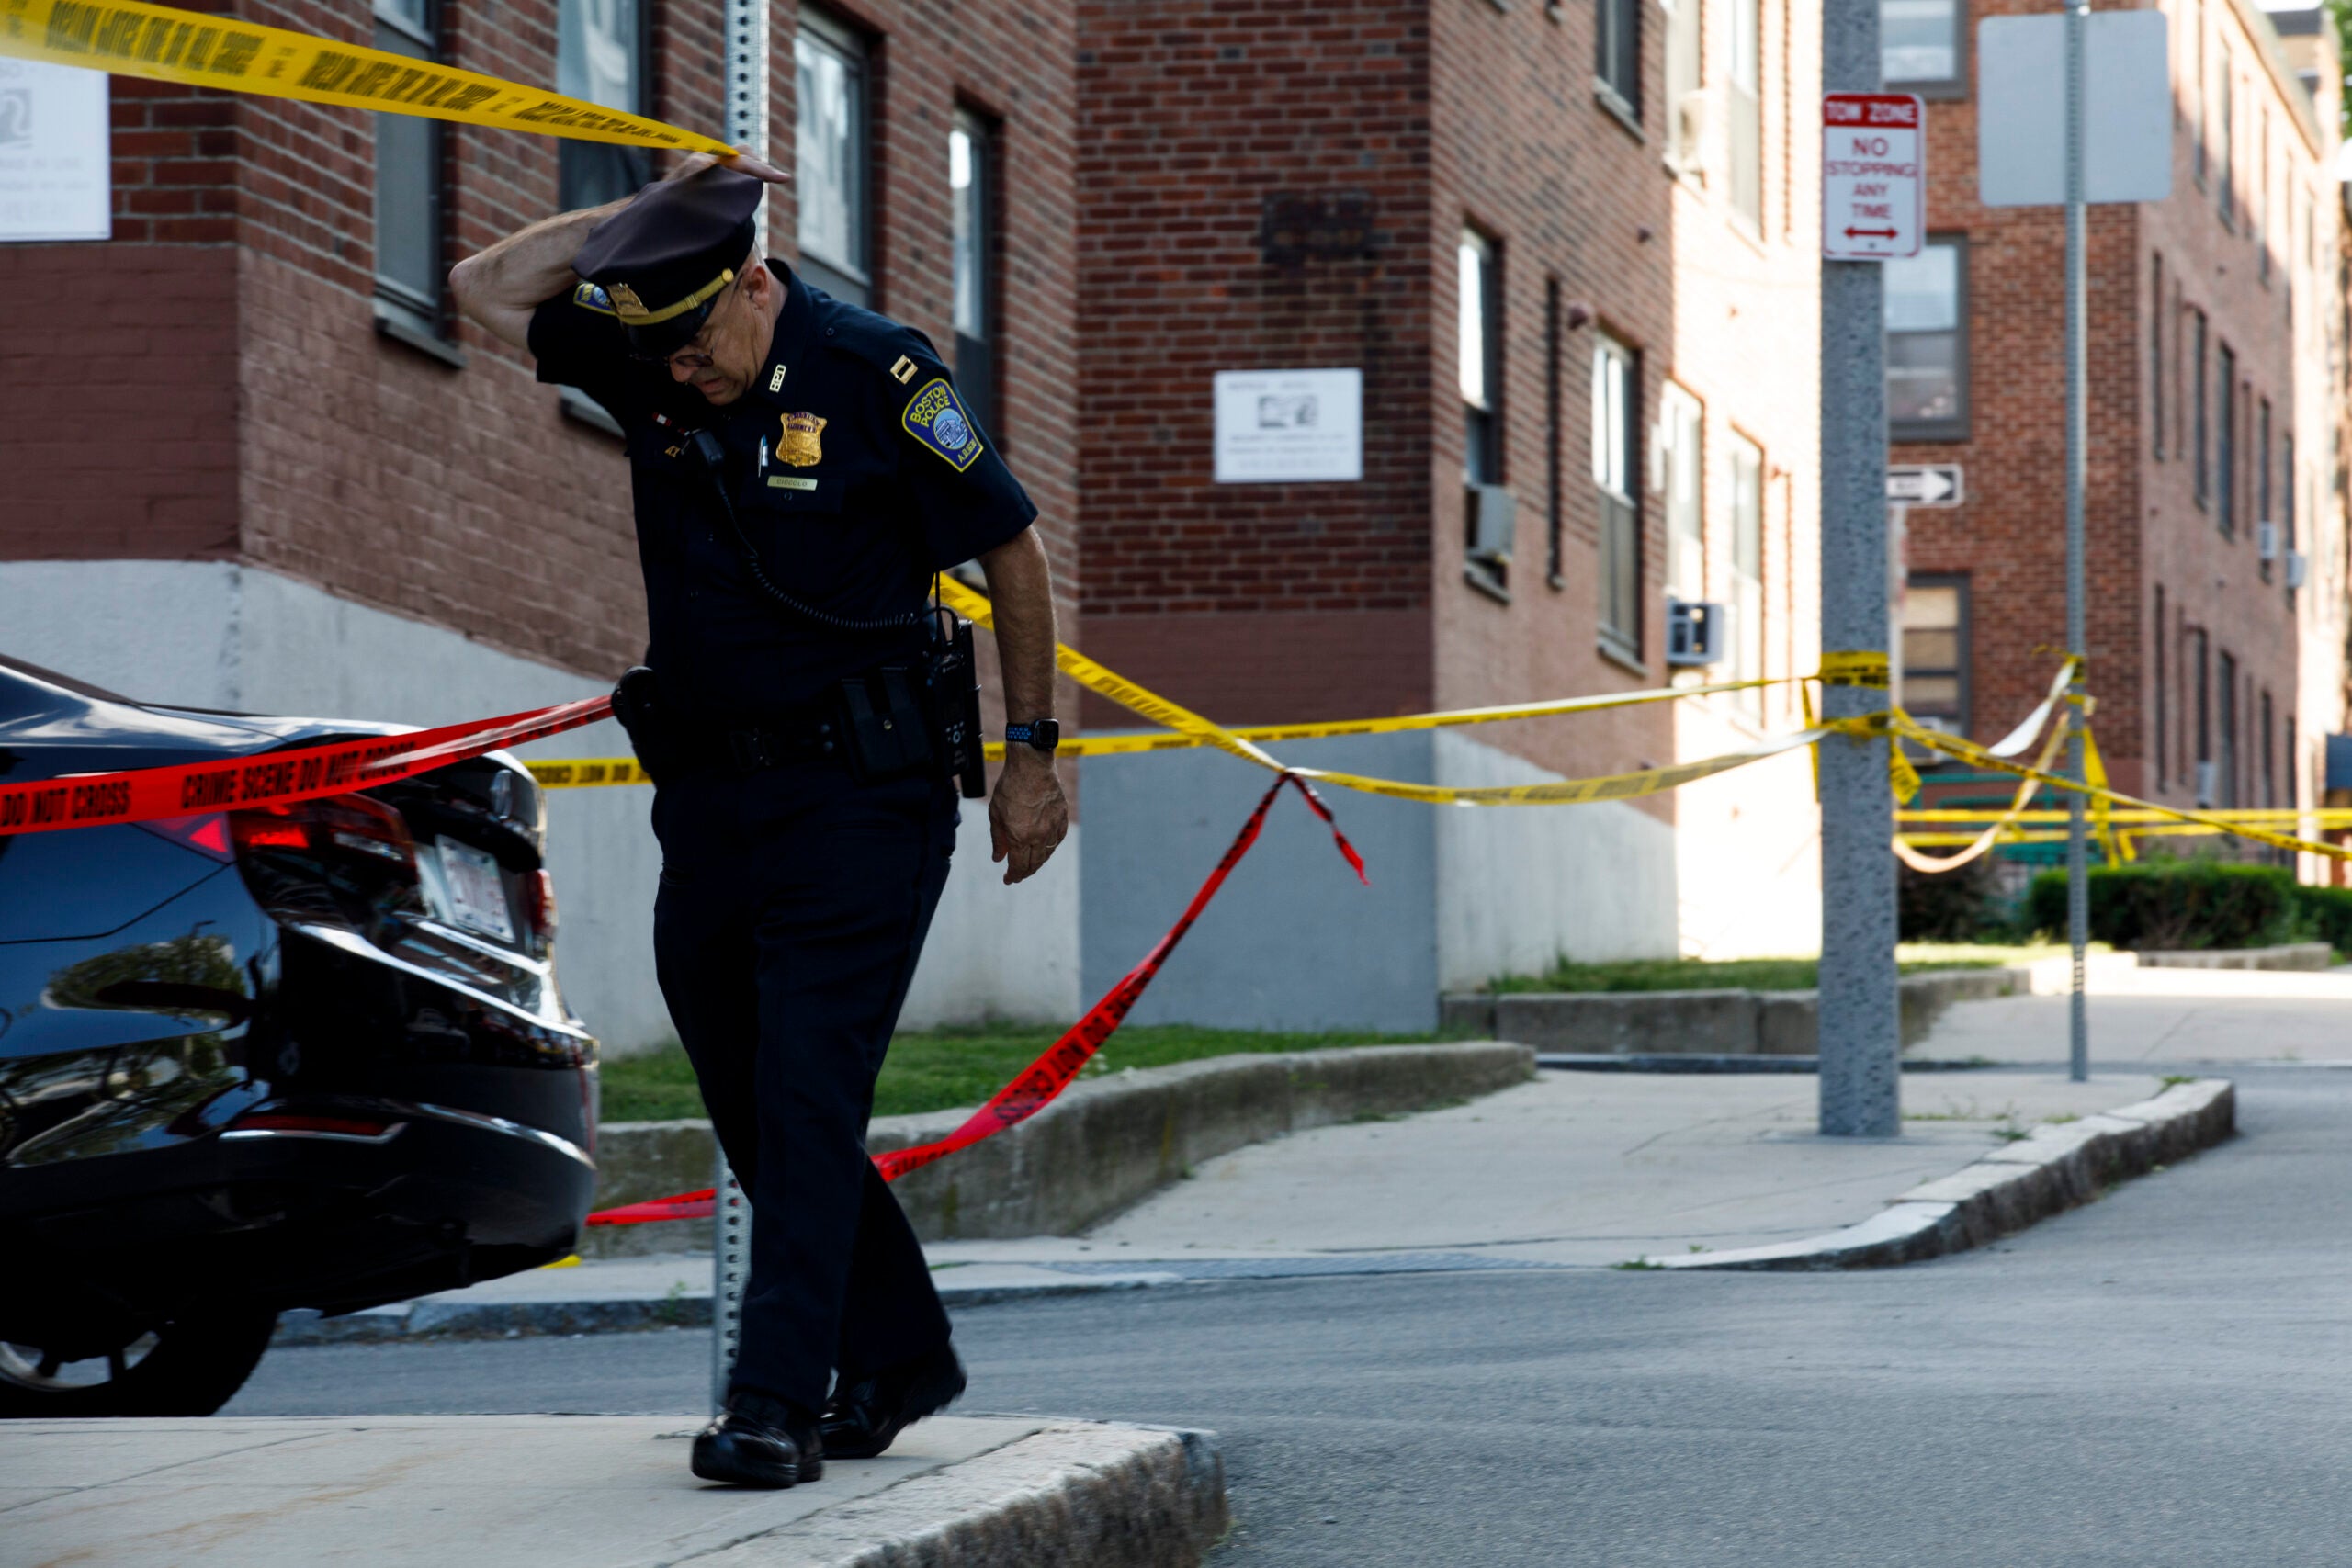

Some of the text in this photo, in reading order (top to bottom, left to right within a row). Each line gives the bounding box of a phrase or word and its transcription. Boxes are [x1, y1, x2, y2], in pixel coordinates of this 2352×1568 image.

[1825, 101, 1915, 123] TOW ZONE
[1852, 138, 1889, 157] NO
[1826, 160, 1917, 178] STOPPING
[1853, 183, 1889, 197] ANY
[1851, 203, 1892, 220] TIME
[910, 385, 948, 423] BOSTON
[920, 395, 951, 428] POLICE
[182, 769, 237, 809] CRIME
[240, 760, 297, 802] SCENE
[297, 755, 323, 793] DO
[323, 749, 359, 788] NOT
[1, 780, 130, 827] DO NOT CROSS
